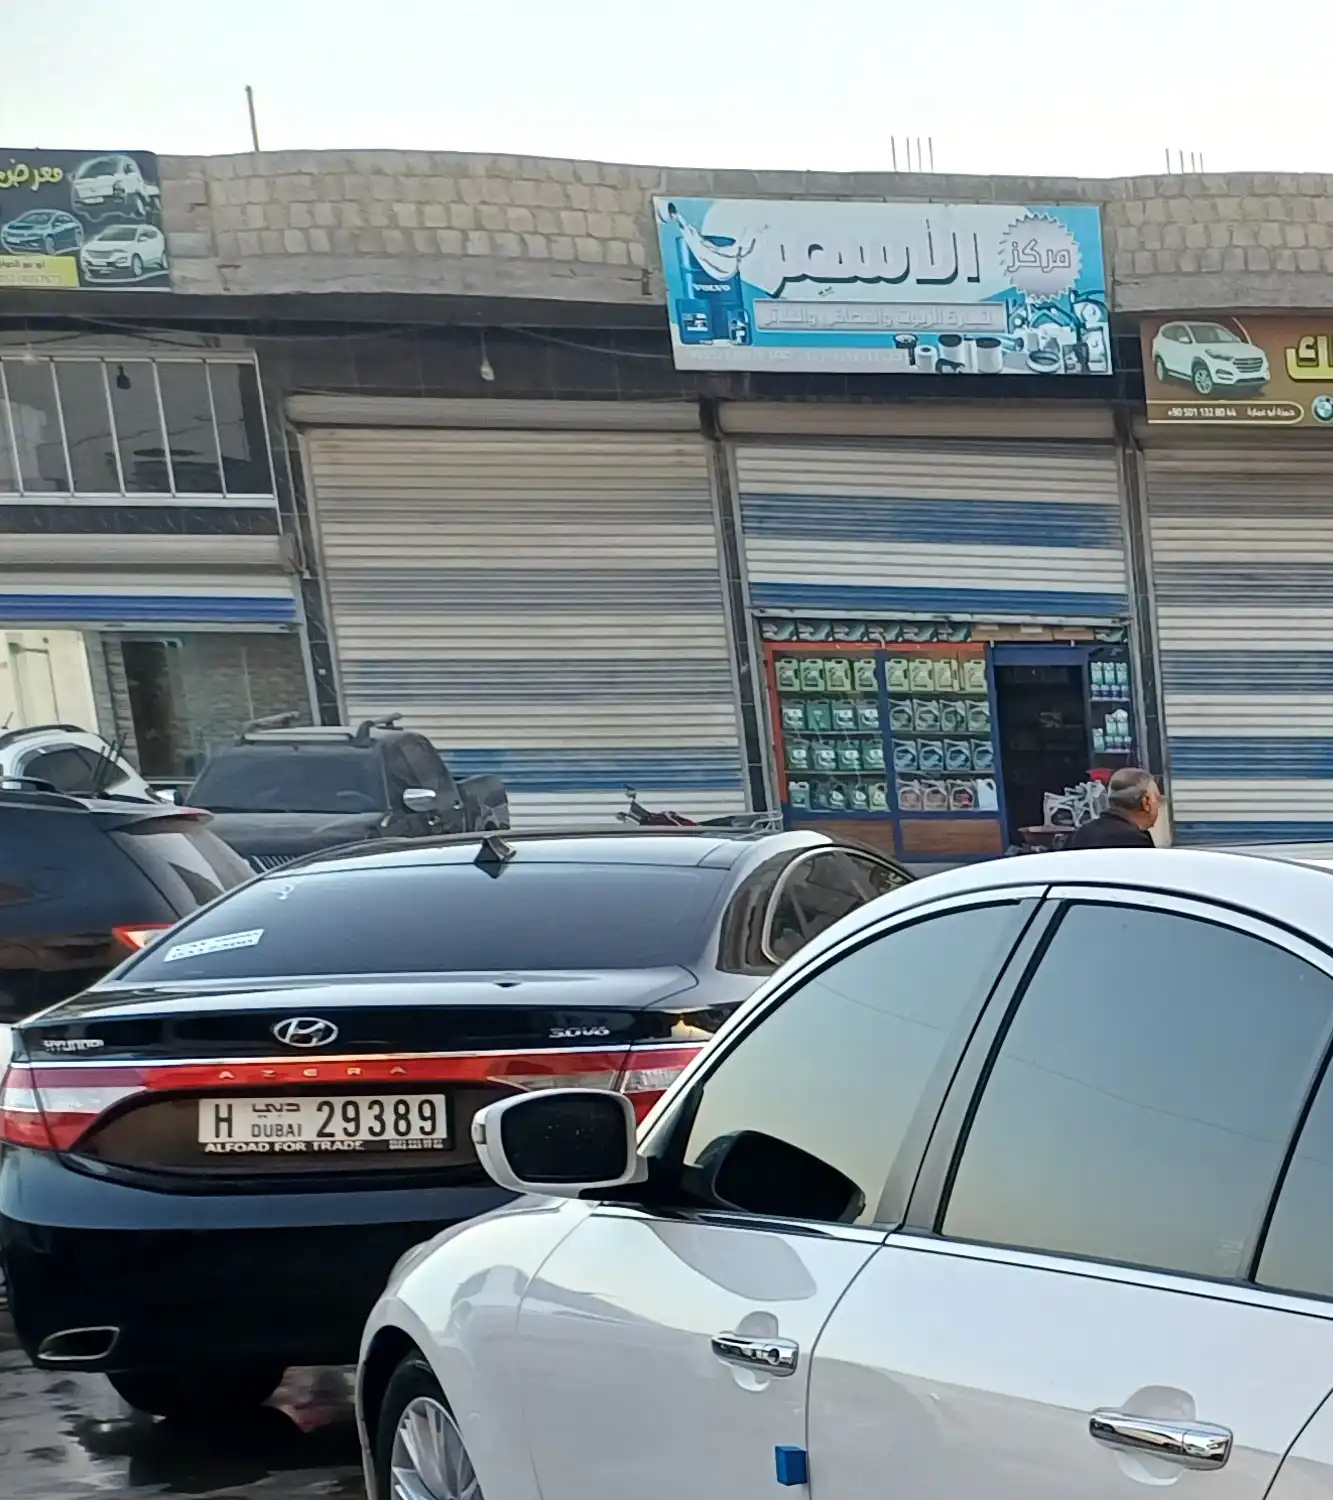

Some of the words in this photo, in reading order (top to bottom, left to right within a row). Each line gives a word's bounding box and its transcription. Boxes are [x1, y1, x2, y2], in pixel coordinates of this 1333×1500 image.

[1006, 239, 1071, 273] مركز
[218, 1065, 408, 1081] AZERA
[252, 1102, 301, 1118] دبي
[214, 1103, 233, 1138] H
[316, 1099, 437, 1138] 29389
[251, 1123, 302, 1138] DUBAI
[275, 1141, 306, 1152] FOR
[312, 1140, 365, 1151] TRADE
